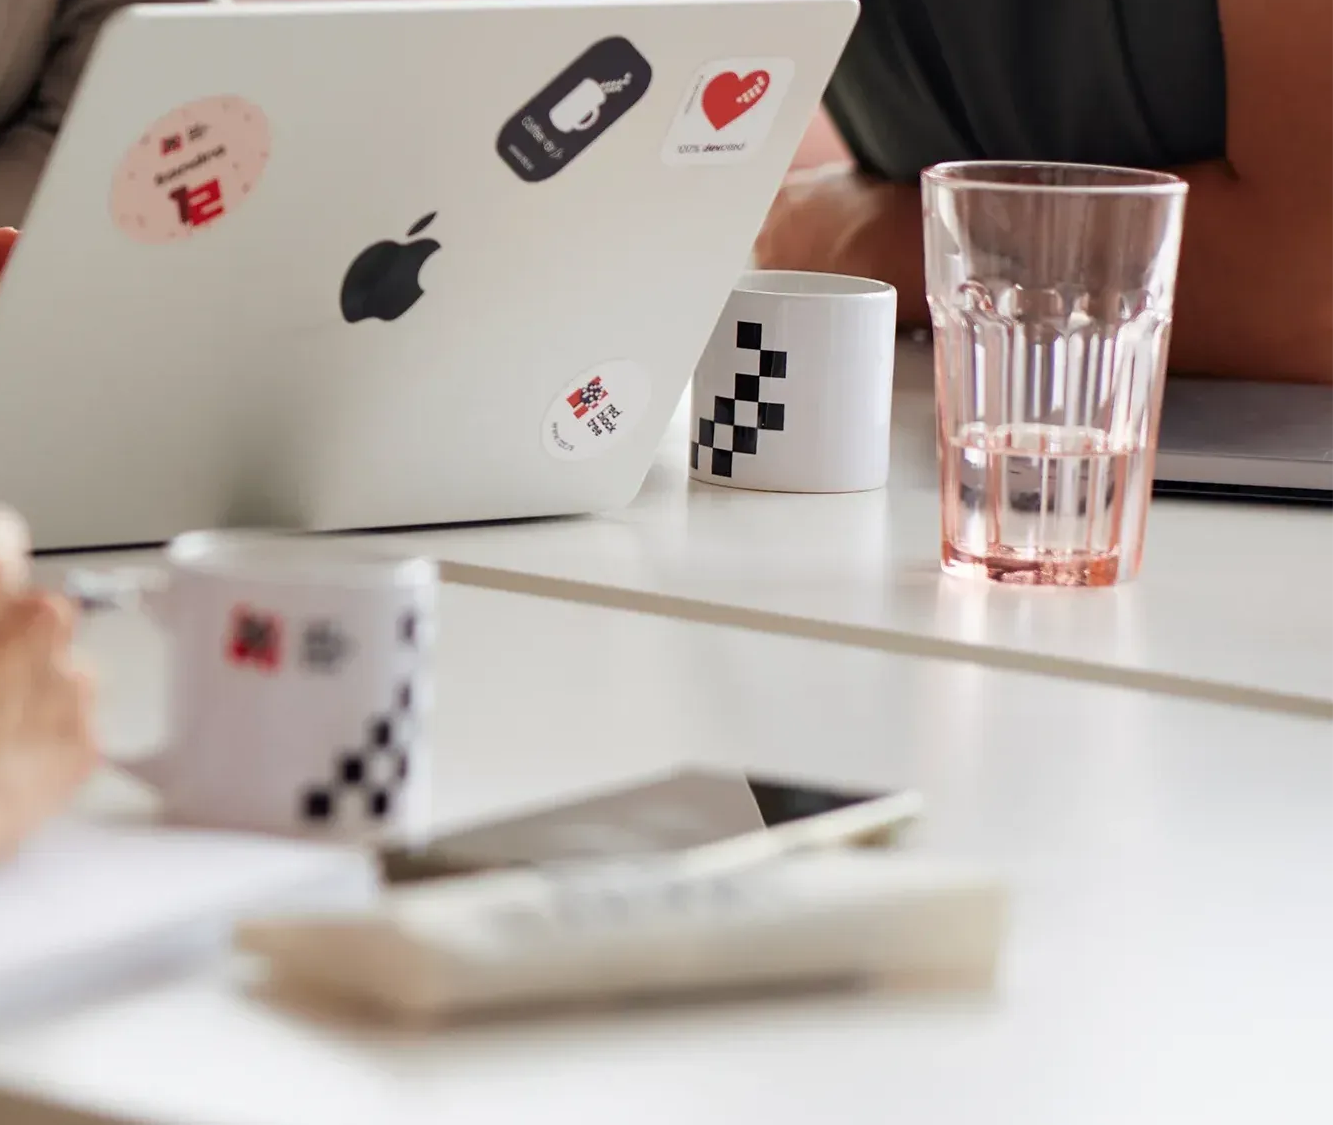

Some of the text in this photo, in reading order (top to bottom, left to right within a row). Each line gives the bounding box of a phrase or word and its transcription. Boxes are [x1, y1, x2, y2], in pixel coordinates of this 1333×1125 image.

[169, 178, 224, 226] 12
[606, 404, 623, 418] red
[587, 419, 603, 436] tree
